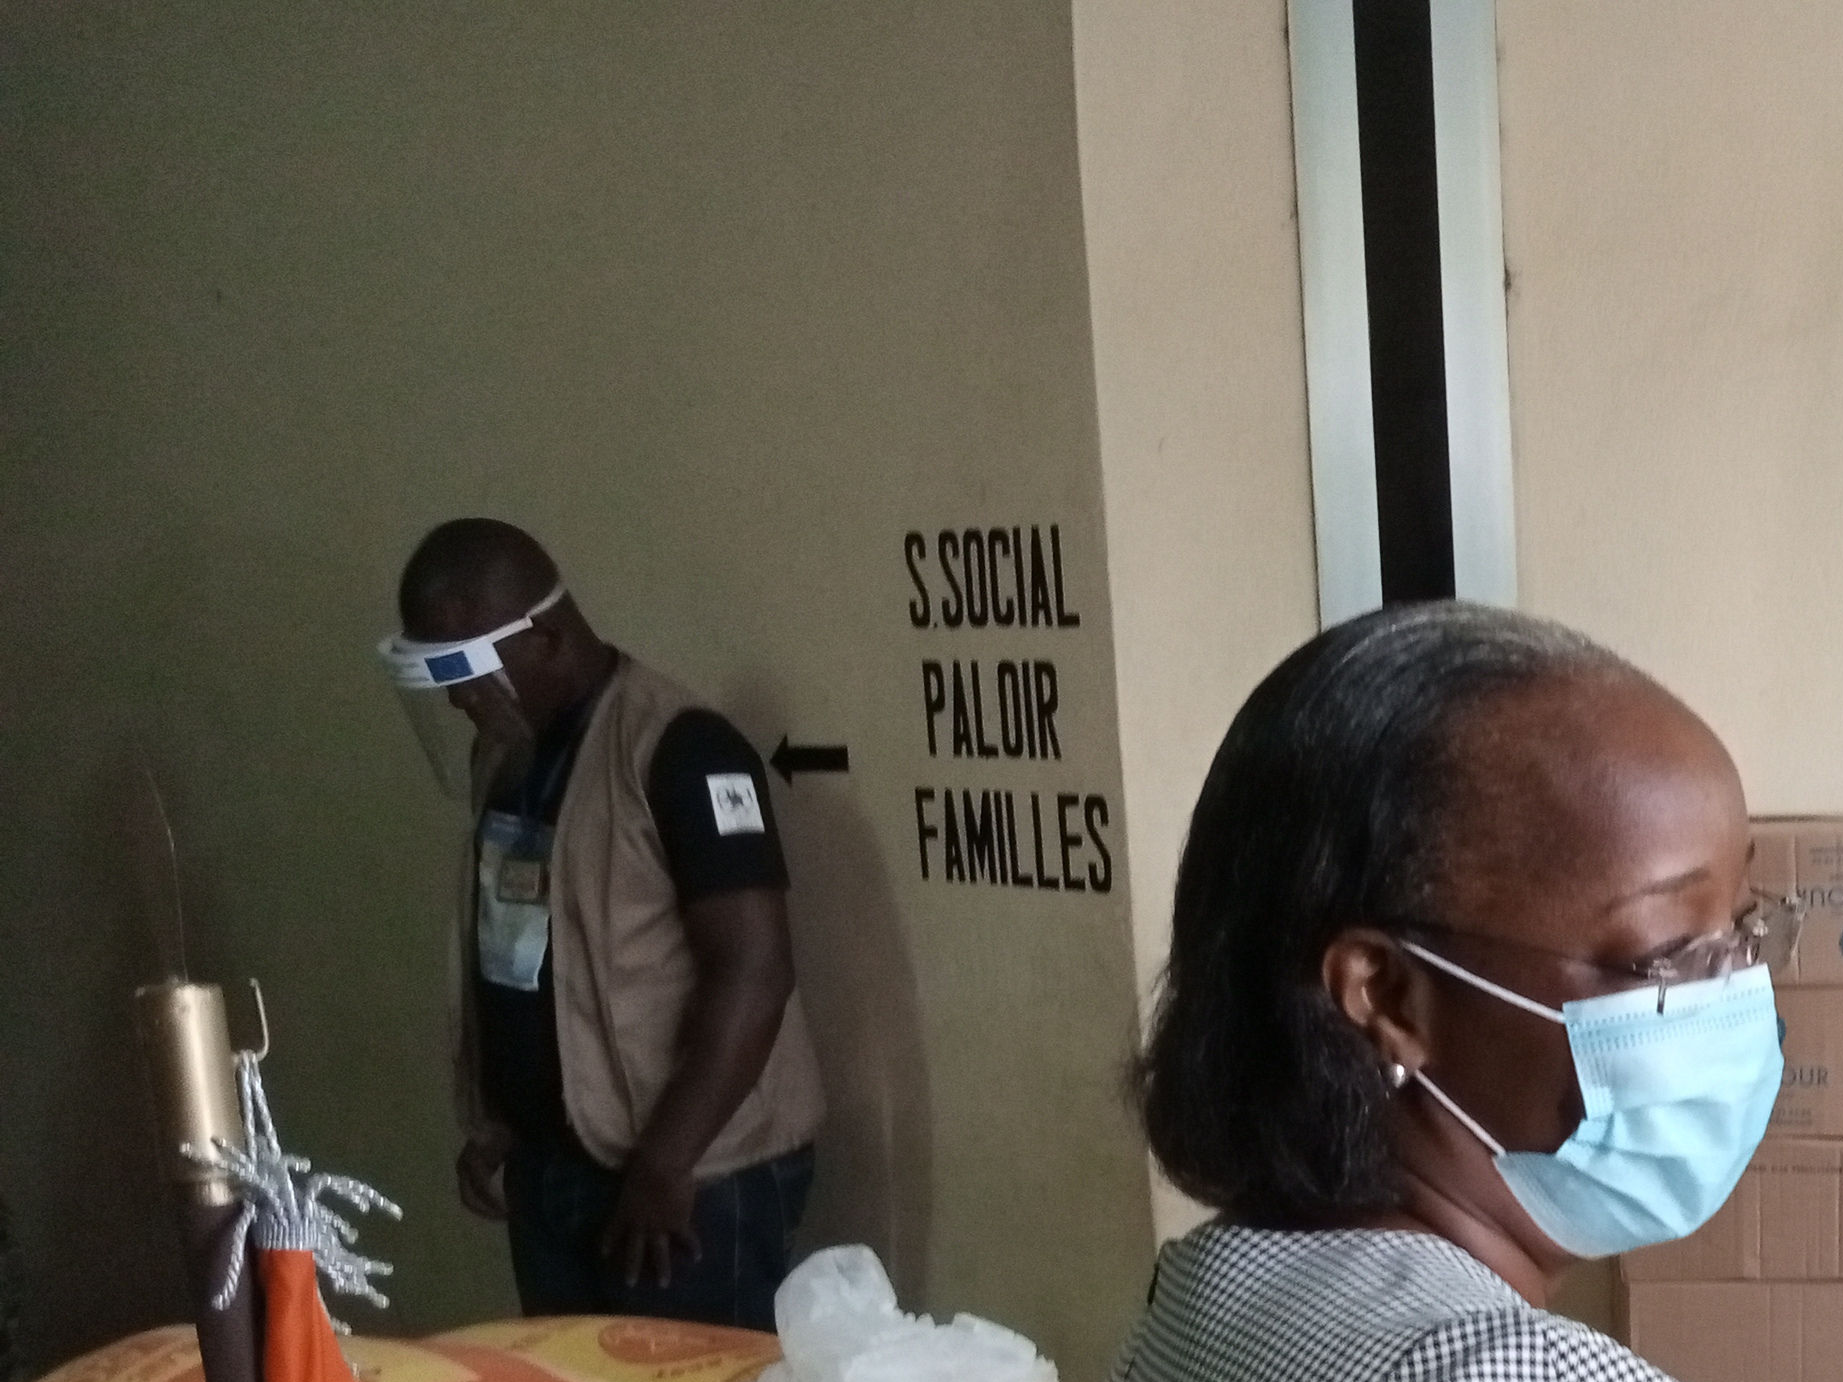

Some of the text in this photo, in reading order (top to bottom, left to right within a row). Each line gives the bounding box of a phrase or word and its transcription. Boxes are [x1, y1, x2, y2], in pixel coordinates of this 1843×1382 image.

[904, 524, 1080, 629] S.SOCIAL
[921, 659, 1062, 760] PALOIR
[914, 788, 1112, 893] FAMILLES
